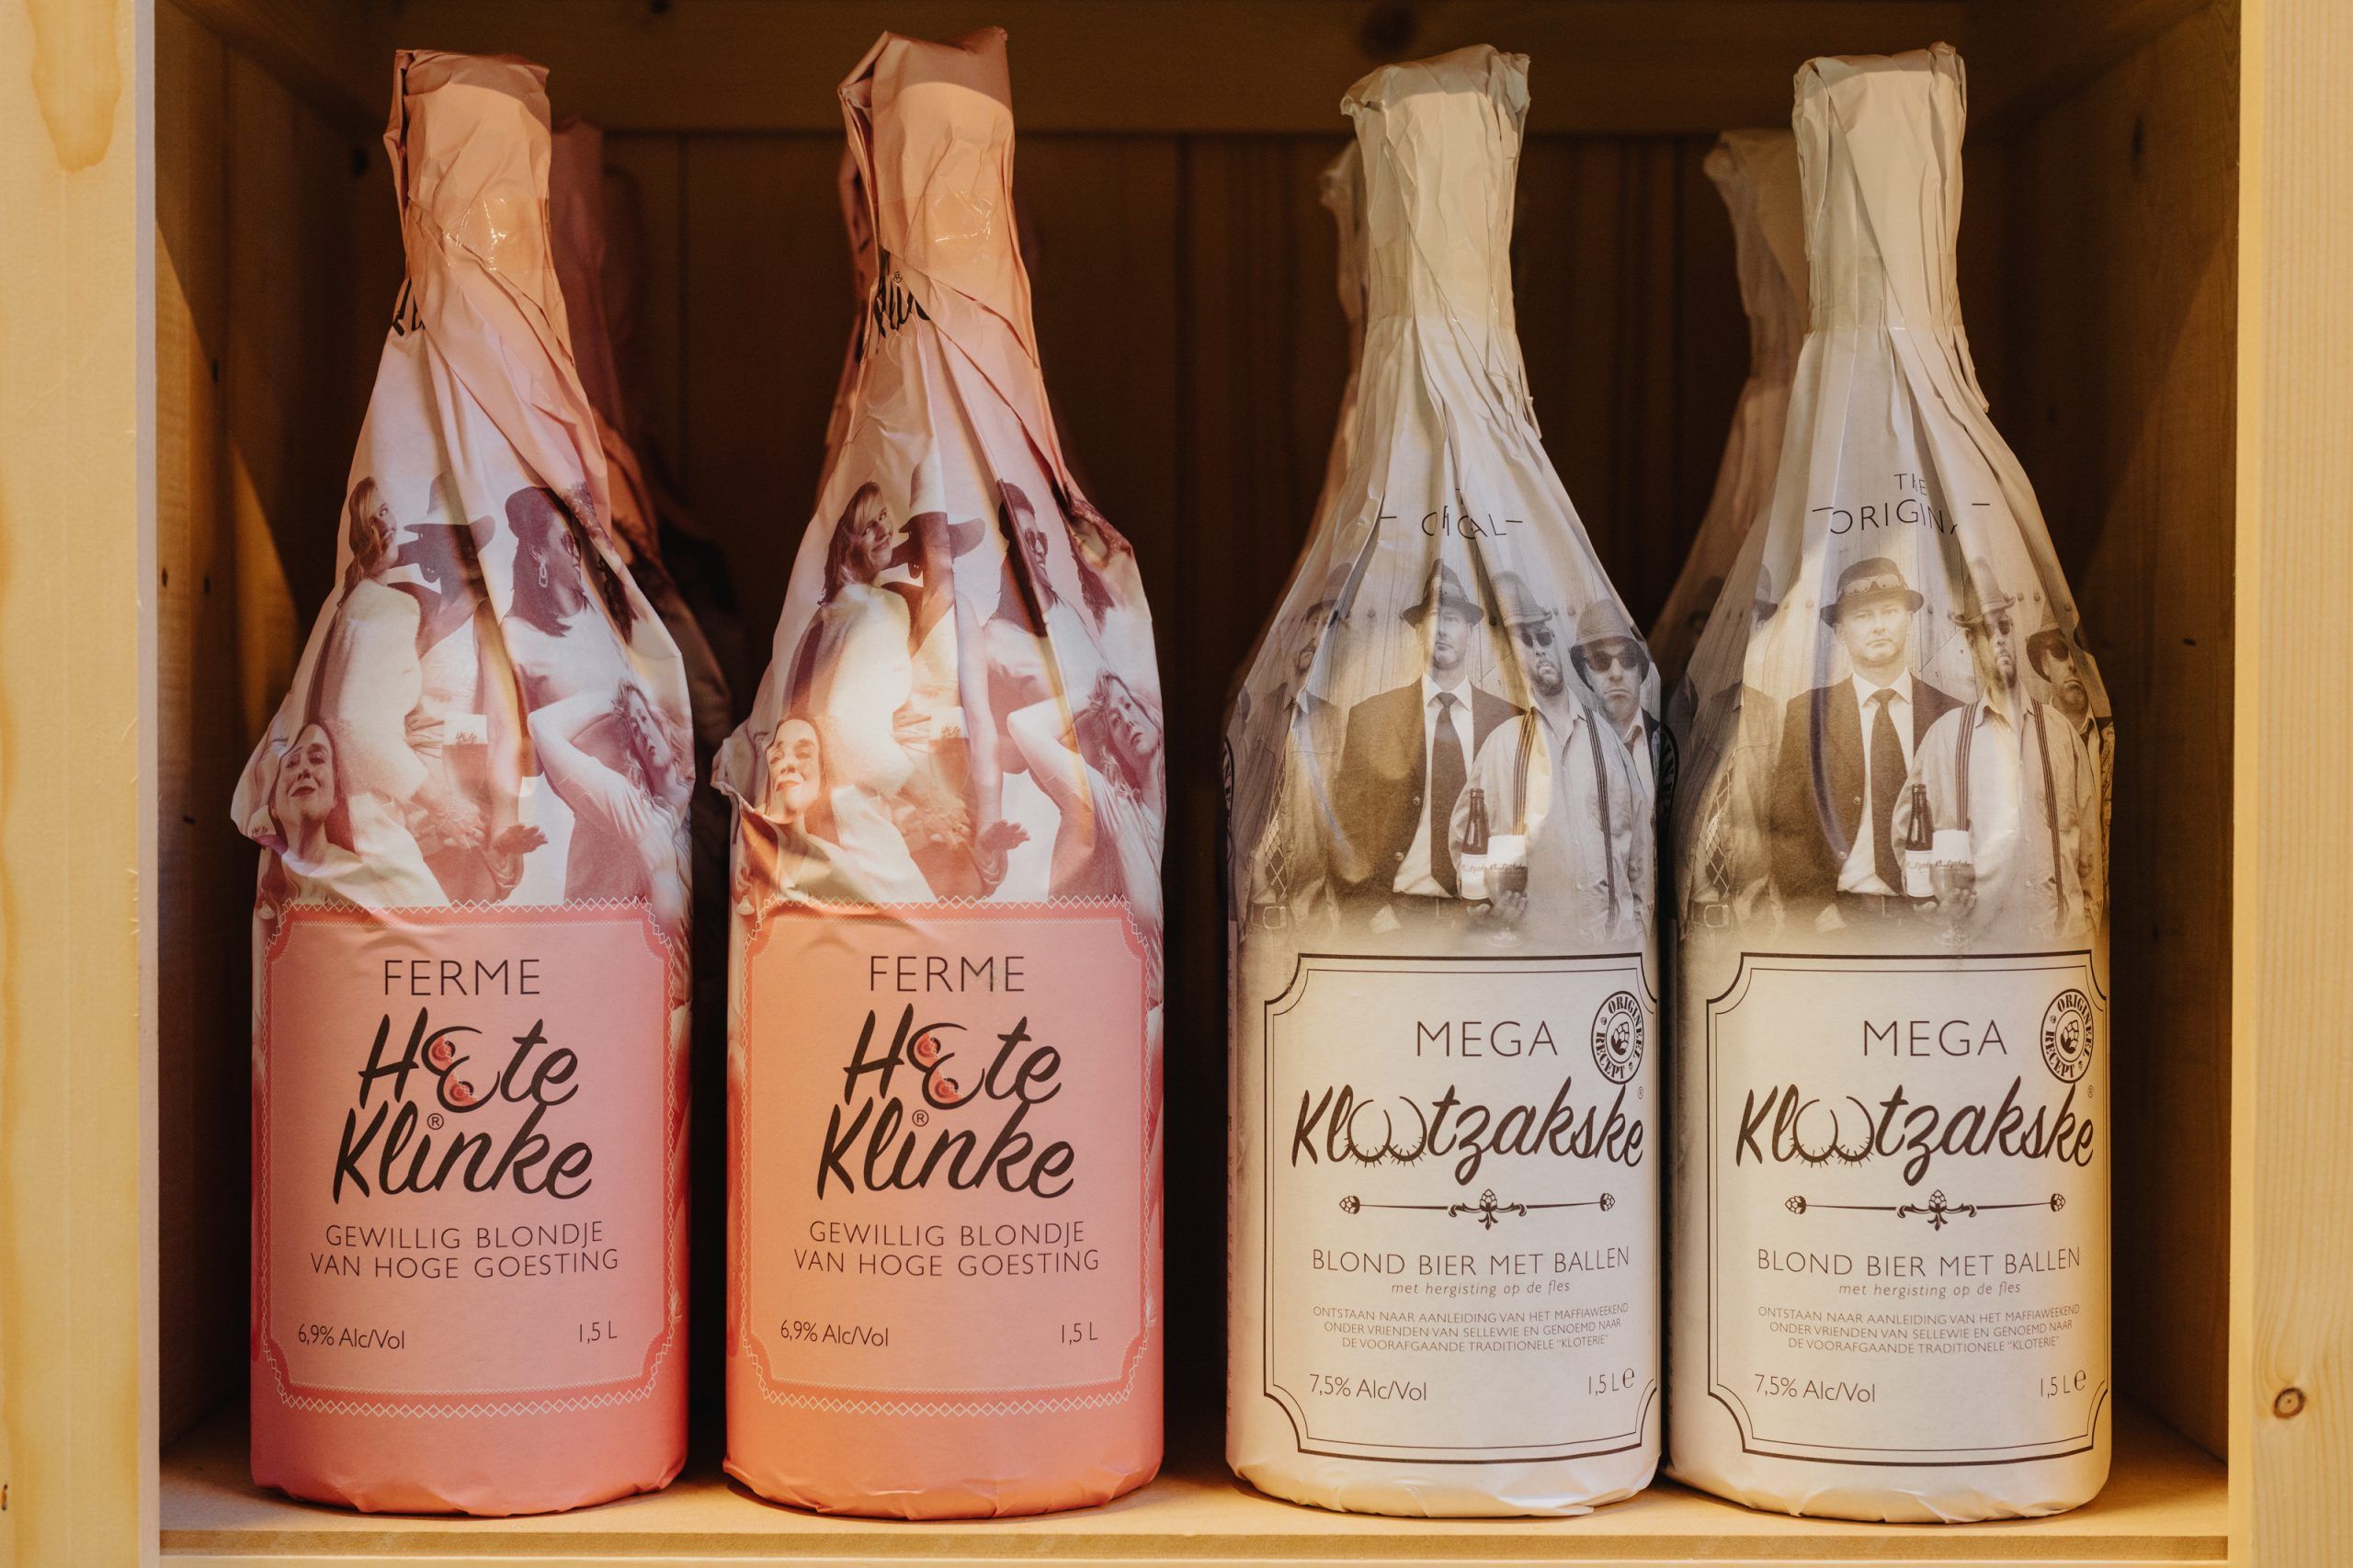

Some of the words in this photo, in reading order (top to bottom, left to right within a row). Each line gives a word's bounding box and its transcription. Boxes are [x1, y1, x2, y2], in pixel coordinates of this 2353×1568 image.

[1830, 499, 1958, 535] ORIGIN
[384, 959, 540, 996] FERME
[870, 956, 1026, 993] FERME
[1416, 1020, 1558, 1058] MEGA
[1863, 1019, 2008, 1058] MEGA
[1595, 1031, 1625, 1079] RECEPT
[2044, 1030, 2075, 1078] RECEPT
[333, 1100, 593, 1204] Klinke
[816, 1096, 1075, 1200] Klinke
[326, 1224, 461, 1250] GEWILLIG
[476, 1221, 604, 1250] BLONDJE
[810, 1221, 945, 1247] GEWILLIG
[961, 1221, 1085, 1248] BLONDJE
[310, 1253, 360, 1278] VAN
[375, 1256, 460, 1279] HOGE
[474, 1249, 619, 1278] GOESTING
[793, 1248, 845, 1273] VAN
[858, 1254, 943, 1277] HOGE
[958, 1249, 1100, 1277] GOESTING
[1313, 1248, 1405, 1275] BLOND
[1419, 1255, 1477, 1276] BIER
[1490, 1253, 1543, 1276] MET
[1554, 1245, 1630, 1274] BALLEN
[1757, 1248, 1854, 1276] BLOND
[1867, 1256, 1927, 1277] BIER
[1939, 1254, 1995, 1277] MET
[2005, 1246, 2080, 1275] BALLEN
[1391, 1282, 1419, 1295] met
[1426, 1282, 1497, 1299] hergisting
[1504, 1283, 1520, 1298] op
[1527, 1280, 1543, 1293] de
[1546, 1279, 1571, 1294] fles
[1838, 1283, 1868, 1295] met
[1873, 1283, 1947, 1300] hergisting
[1953, 1284, 1971, 1299] op
[1977, 1282, 1994, 1295] de
[1997, 1280, 2021, 1296] fles
[1313, 1306, 1376, 1322] ONTSTAAN
[1380, 1312, 1415, 1324] NAAR
[1418, 1312, 1497, 1324] AANLEIDING
[1500, 1312, 1526, 1324] VAN
[1529, 1310, 1551, 1323] HET
[1554, 1302, 1630, 1321] MAFFIAWEEKEND
[1757, 1306, 1823, 1322] ONTSTAAN
[1826, 1312, 1864, 1324] NAAR
[1867, 1313, 1947, 1325] AANLEIDING
[1949, 1313, 1975, 1325] VAN
[1979, 1312, 2002, 1324] HET
[2006, 1303, 2081, 1323] MAFFIAWEEKEND
[297, 1324, 335, 1347] 6,9%
[339, 1328, 405, 1350] Alc/Vol
[578, 1322, 602, 1345] 1,5
[608, 1321, 618, 1340] L
[779, 1320, 818, 1344] 6,9%
[822, 1325, 889, 1347] Alc/Vol
[1061, 1322, 1084, 1345] 1,5
[1088, 1320, 1098, 1341] L
[1324, 1322, 1365, 1335] ONDER
[1367, 1324, 1430, 1338] VRIENDEN
[1431, 1326, 1460, 1338] VAN
[1463, 1326, 1519, 1338] SELLEWIE
[1523, 1326, 1540, 1337] EN
[1542, 1321, 1597, 1336] GENOEMD
[1598, 1318, 1622, 1331] NAAR
[1769, 1322, 1813, 1335] ONDER
[1813, 1325, 1879, 1339] VRIENDEN
[1880, 1328, 1909, 1340] VAN
[1912, 1327, 1970, 1340] SELLEWIE
[1973, 1327, 1990, 1338] EN
[1993, 1322, 2047, 1337] GENOEMD
[2049, 1319, 2074, 1332] NAAR
[1342, 1337, 1358, 1349] DE
[1359, 1338, 1466, 1353] VOORAFGAANDE
[1469, 1339, 1554, 1353] TRADITIONELE
[1788, 1337, 1805, 1349] DE
[1805, 1338, 1915, 1354] VOORAFGAANDE
[1917, 1340, 2006, 1354] TRADITIONELE
[1309, 1373, 1351, 1397] 7,5%
[1356, 1379, 1427, 1401] Alc/Vol
[1588, 1374, 1608, 1397] 1,5
[1611, 1371, 1620, 1392] L
[1753, 1373, 1798, 1398] 7,5%
[1802, 1380, 1876, 1403] Alc/Vol
[2039, 1375, 2059, 1399] 1,5
[2062, 1373, 2071, 1394] L
